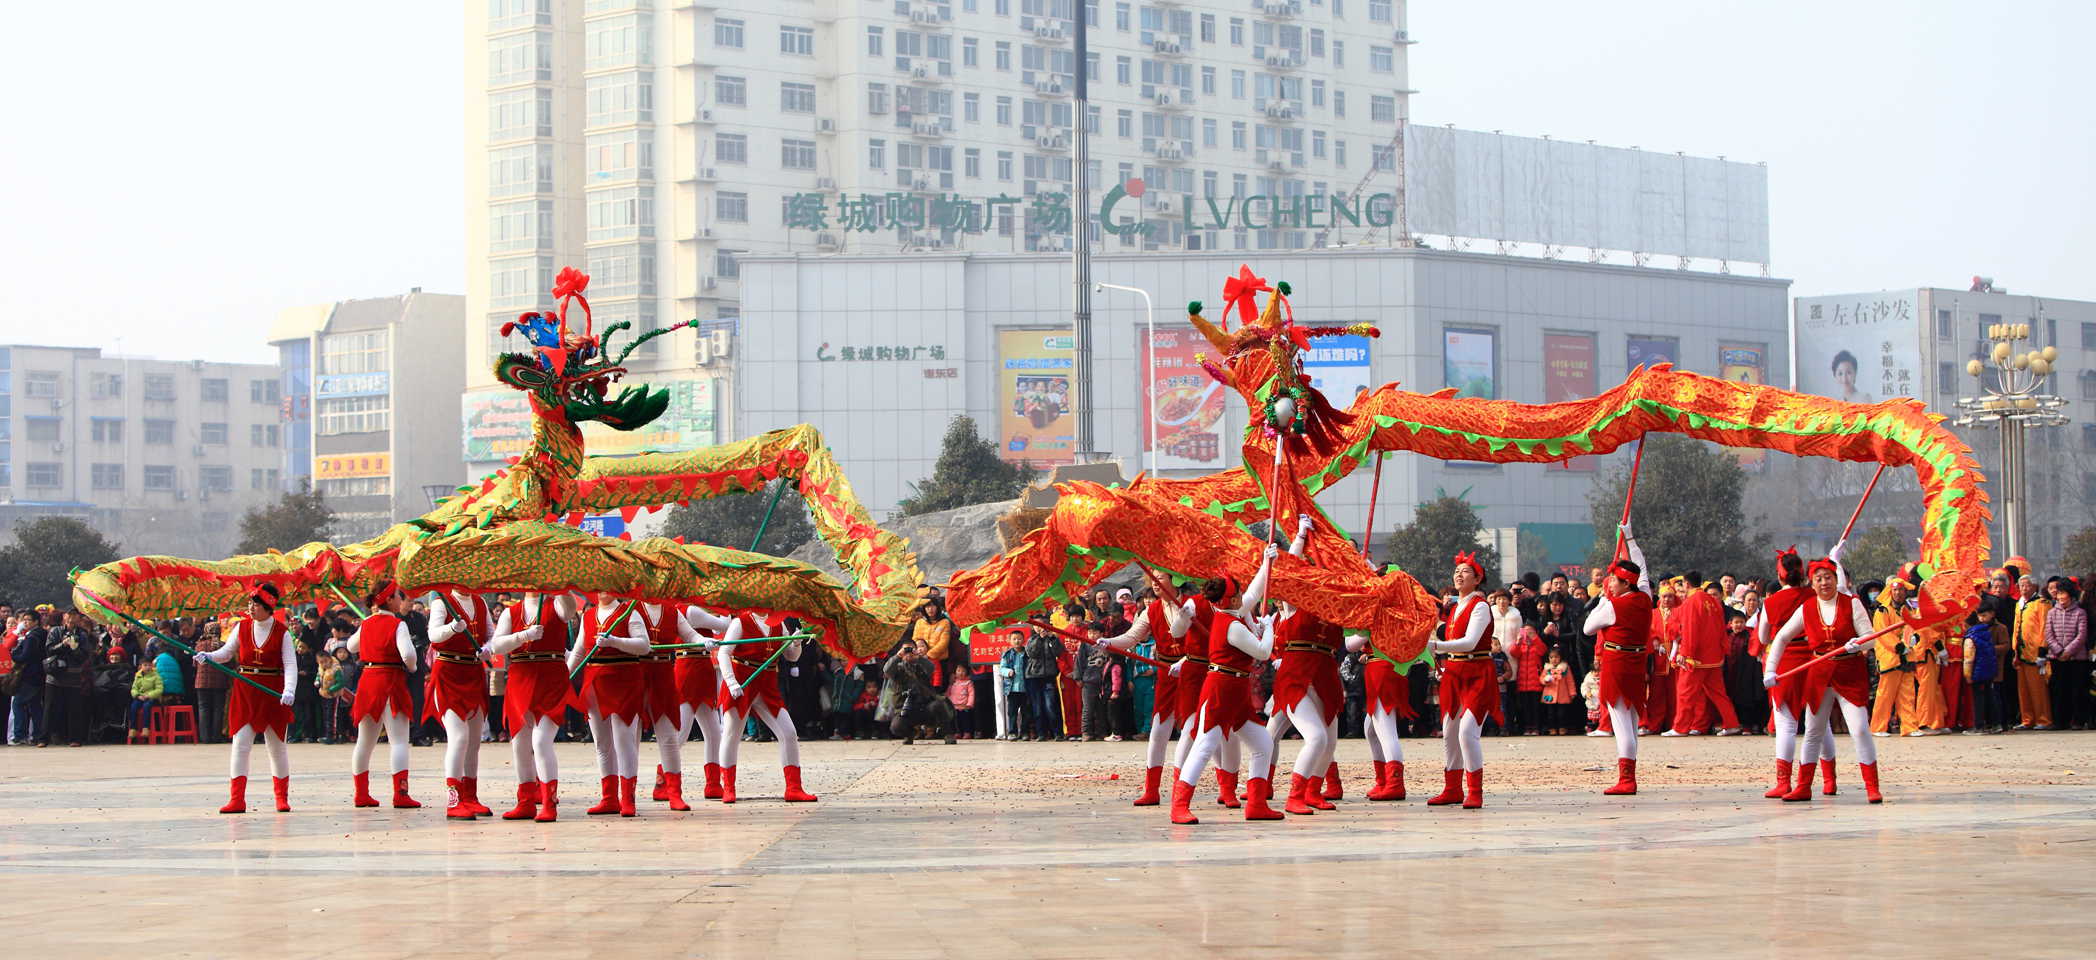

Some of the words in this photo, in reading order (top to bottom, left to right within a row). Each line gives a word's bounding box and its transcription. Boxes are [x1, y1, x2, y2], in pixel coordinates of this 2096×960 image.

[785, 192, 1073, 233] 绿城购物广场
[1183, 193, 1394, 230] LVCHENG
[1832, 299, 1911, 326] 左右沙发
[840, 345, 945, 361] 绿城购物广场
